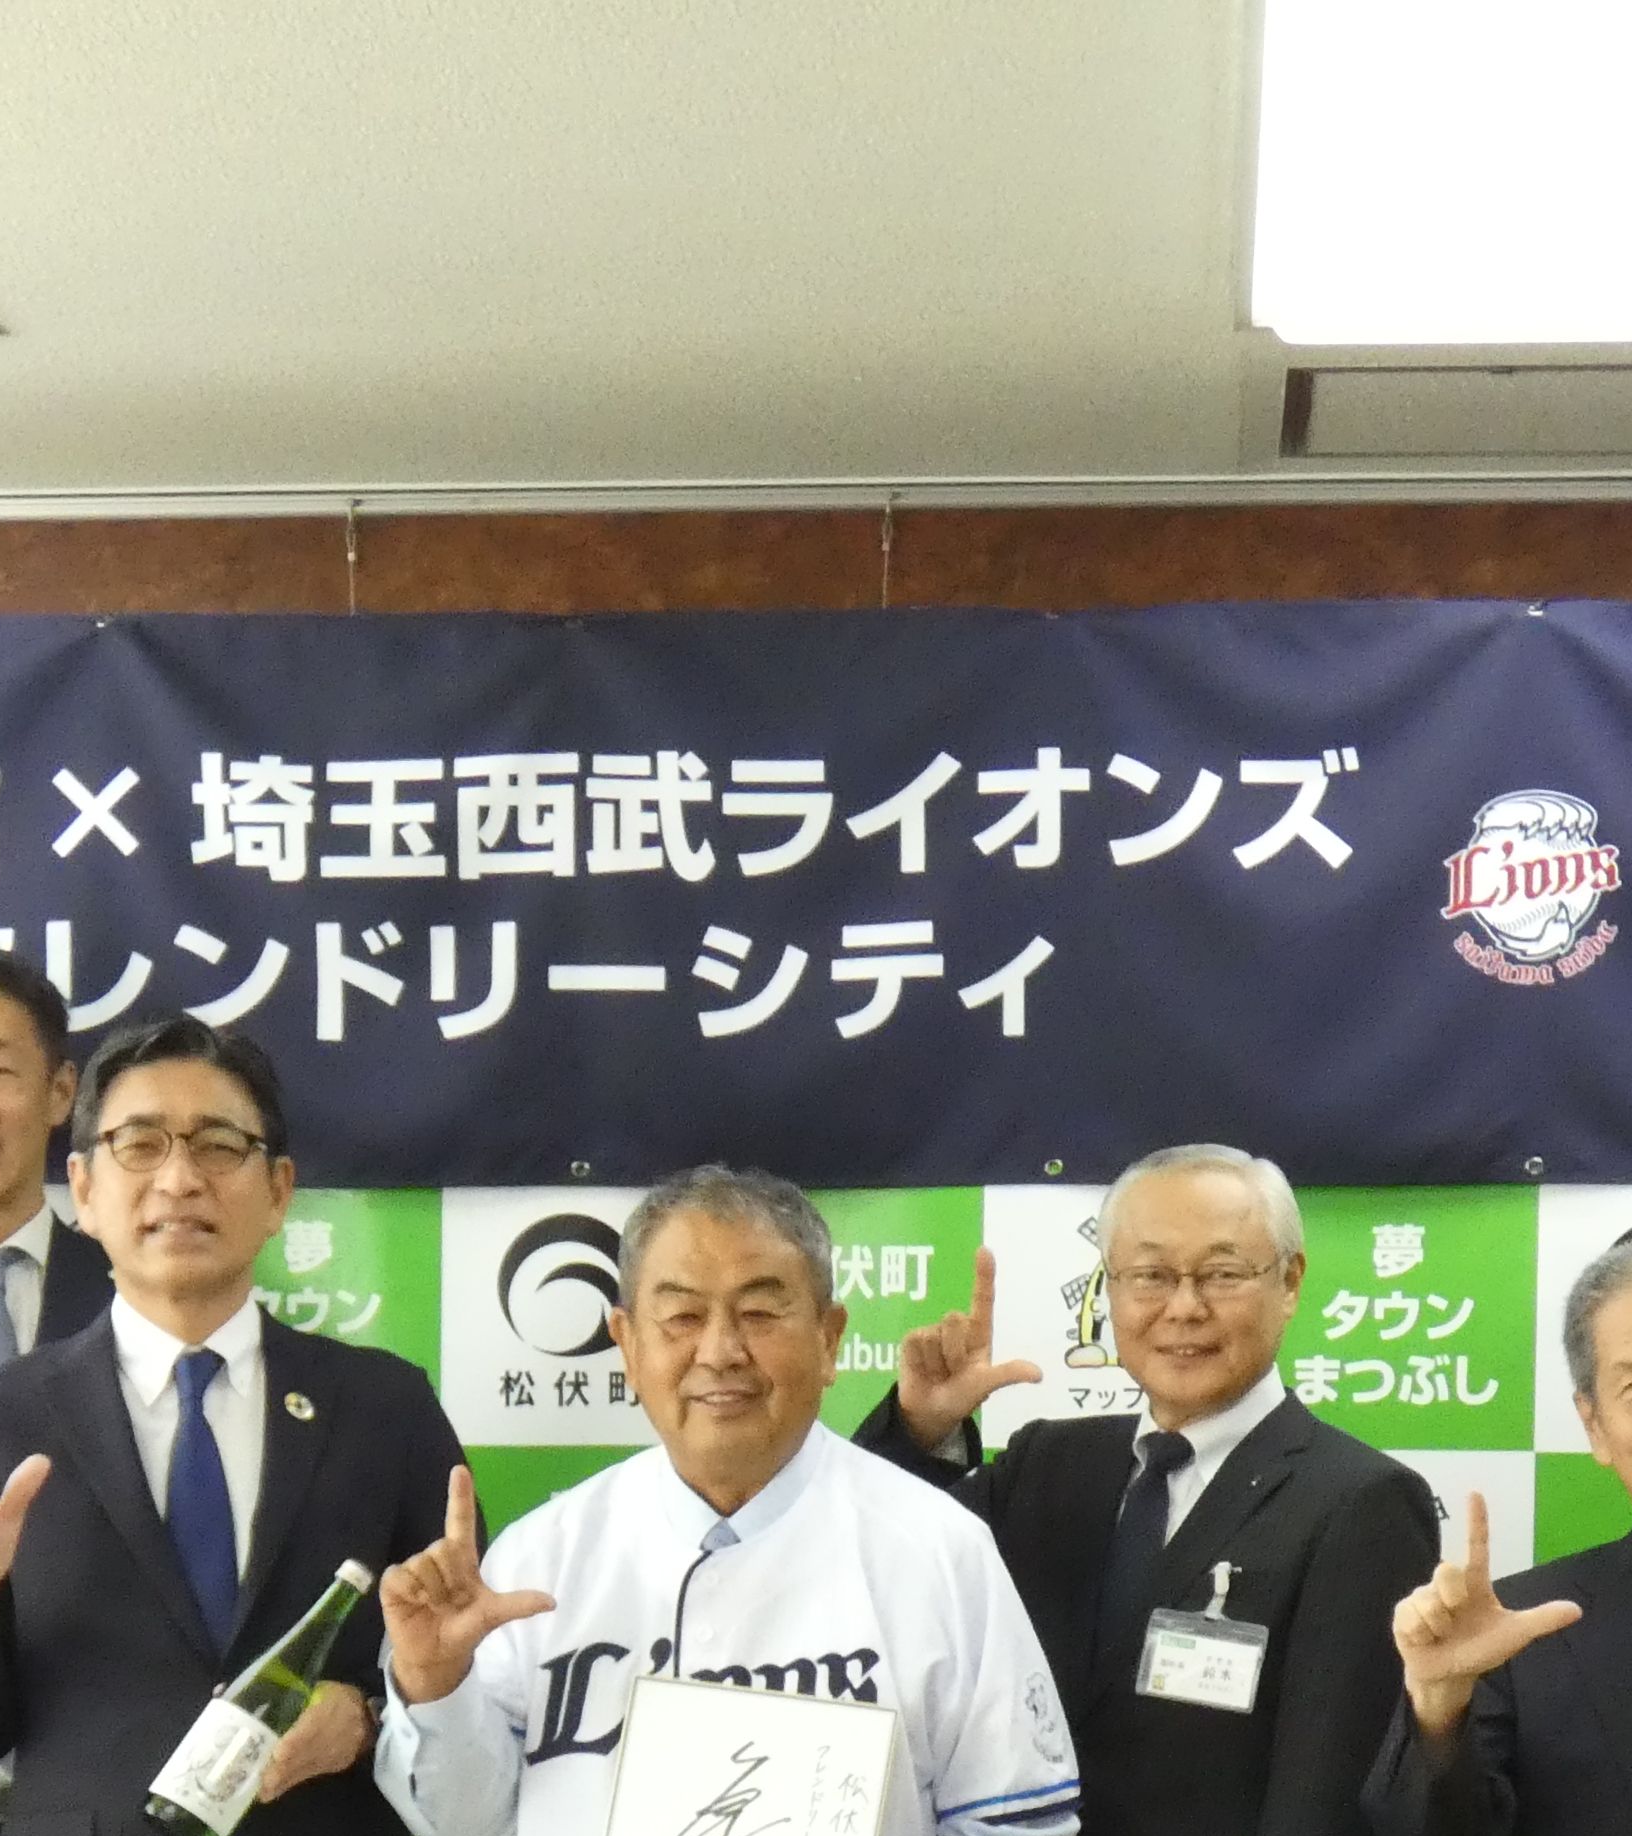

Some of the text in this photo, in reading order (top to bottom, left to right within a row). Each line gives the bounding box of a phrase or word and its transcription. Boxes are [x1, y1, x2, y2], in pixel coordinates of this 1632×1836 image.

[191, 747, 1360, 882] 埼玉西武ライオンズ
[1441, 840, 1622, 919] Lions
[283, 1220, 333, 1274] 夢
[1373, 1224, 1425, 1278] 夢
[1322, 1290, 1475, 1340] タウン
[1295, 1355, 1499, 1405] まつぶし
